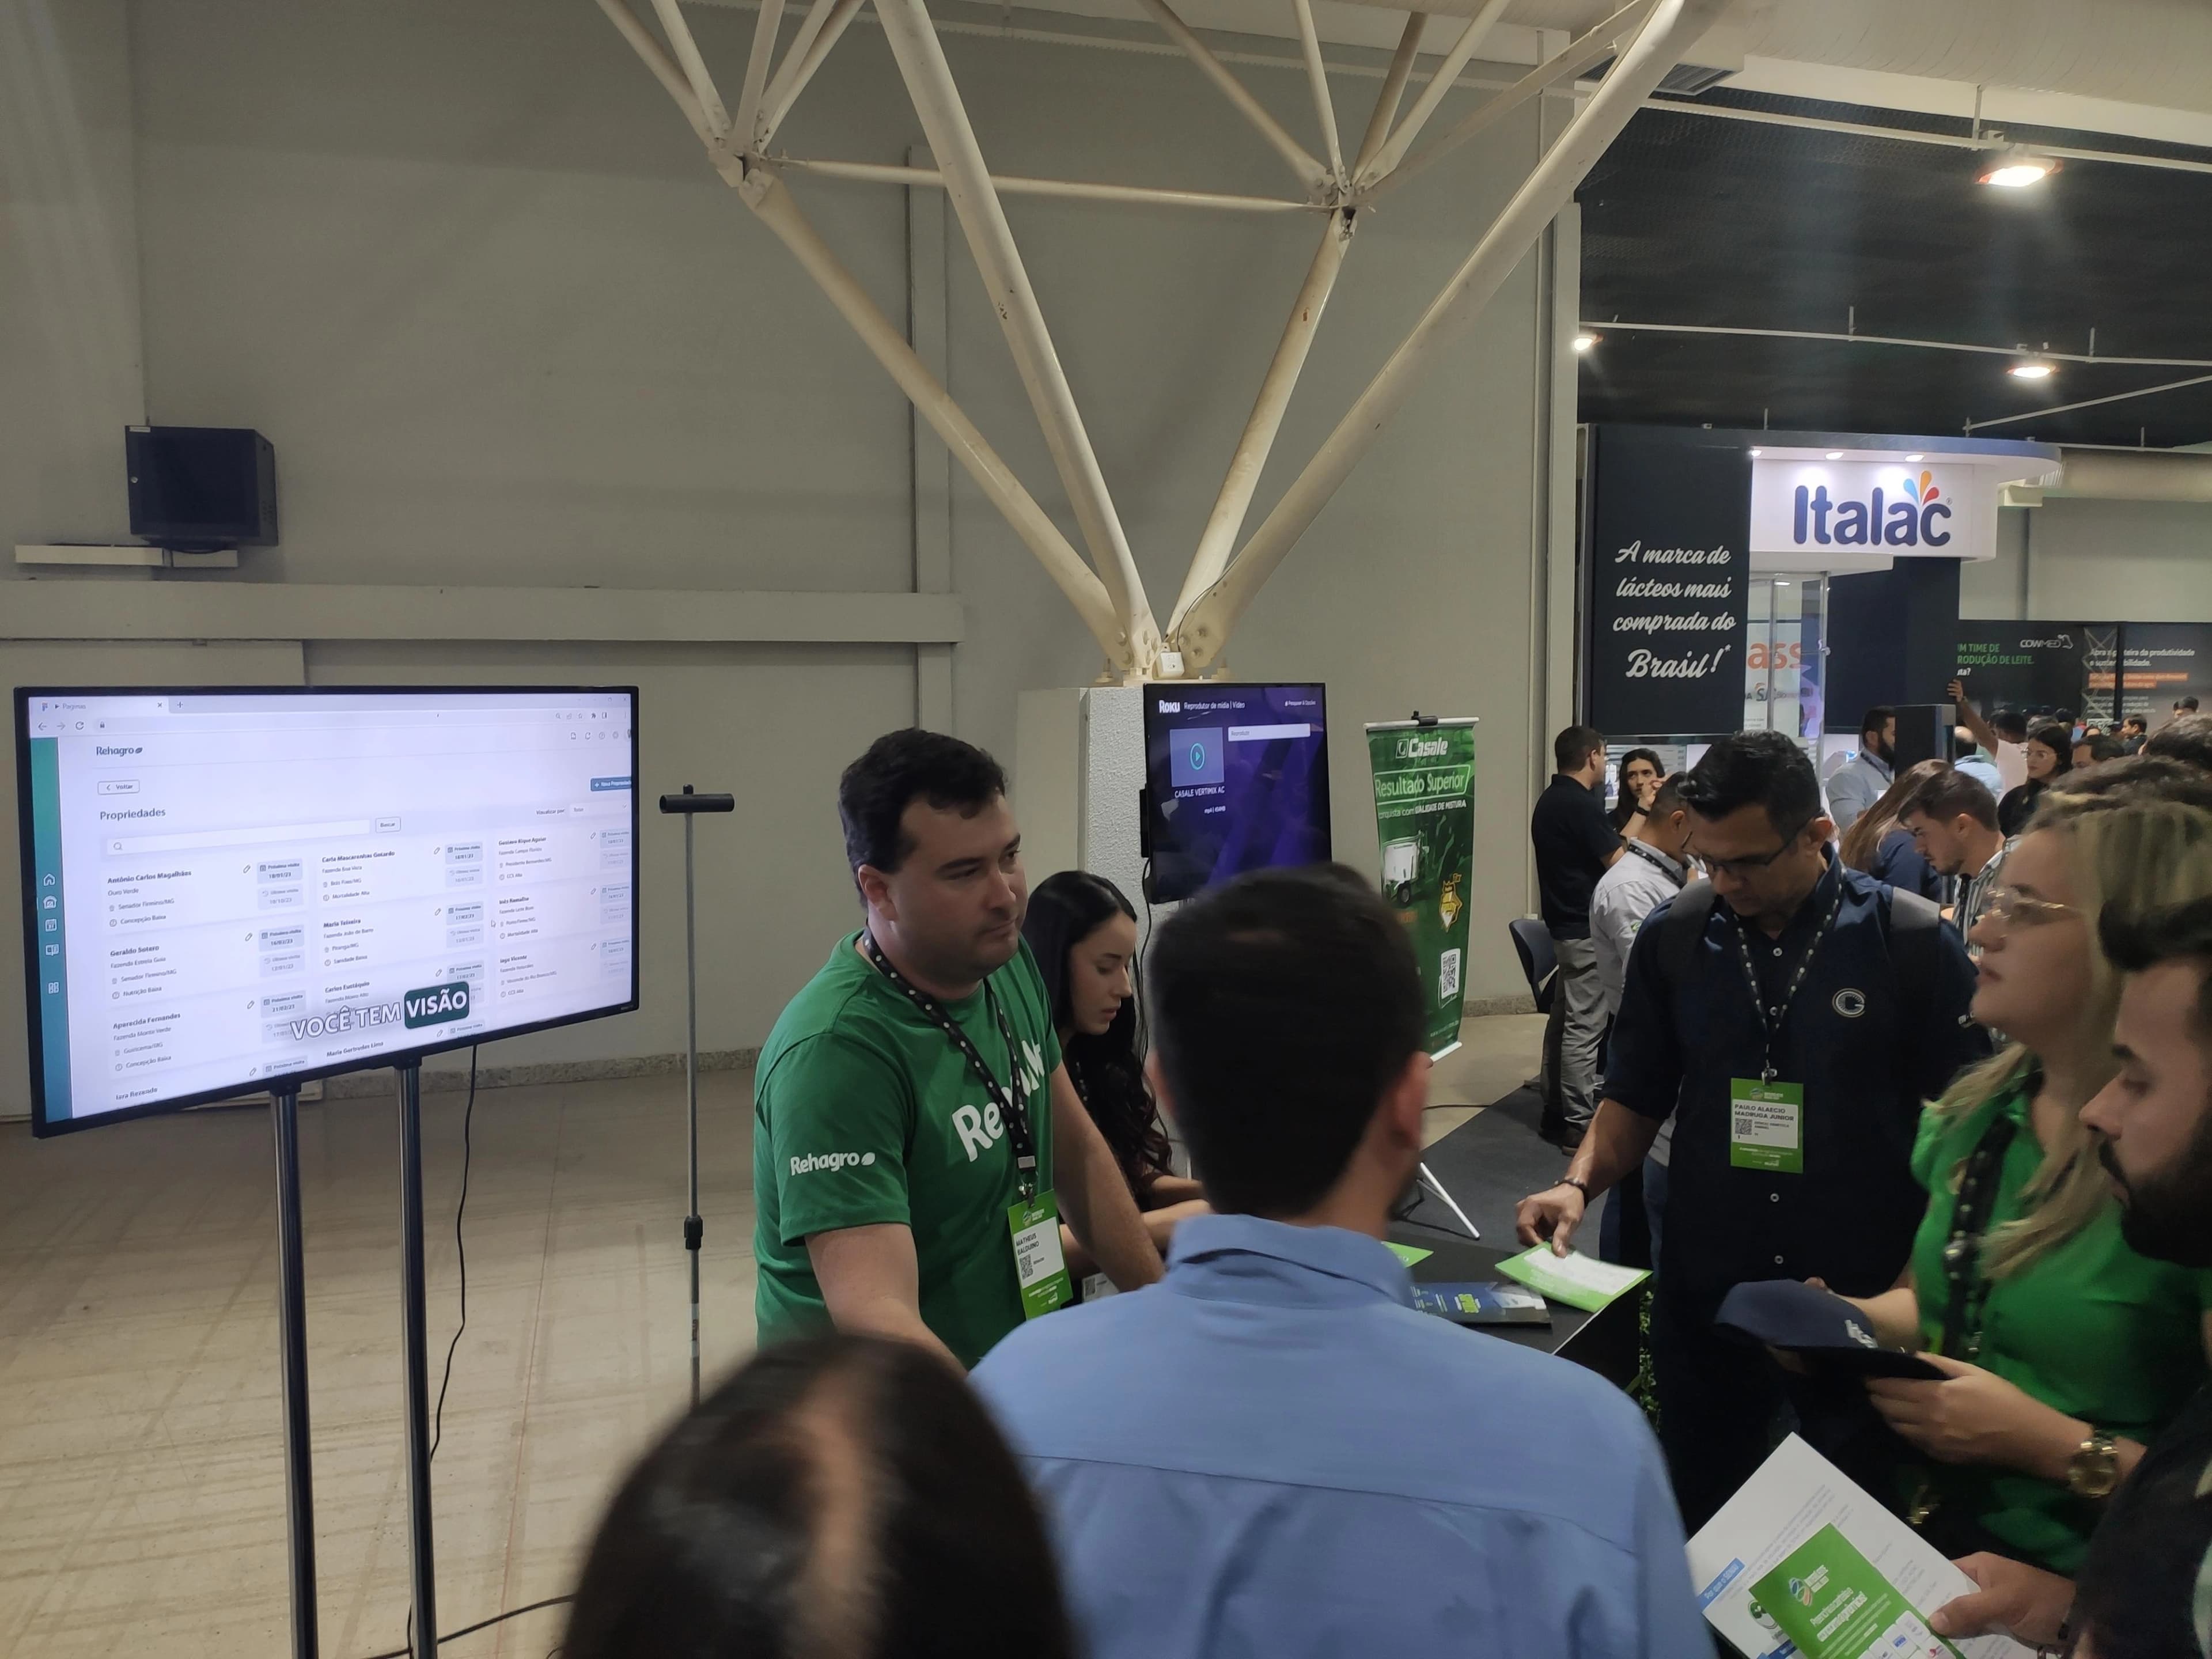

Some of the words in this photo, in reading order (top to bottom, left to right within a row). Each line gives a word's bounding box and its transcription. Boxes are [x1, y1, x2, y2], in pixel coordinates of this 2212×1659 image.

[1794, 485, 1951, 547] Italac
[1615, 540, 1641, 563] A
[1642, 548, 1706, 564] marca
[1706, 545, 1732, 565] de
[1616, 576, 1683, 597] lácteos
[1684, 576, 1732, 598] mais
[1612, 611, 1710, 635] comprada
[1710, 611, 1736, 631] do
[1968, 643, 1987, 652] TIME
[1989, 643, 2000, 652] DE
[2149, 649, 2195, 658] produtividade
[1999, 656, 2010, 664] DE
[1184, 702, 1210, 710] Reprodutor
[96, 746, 134, 757] Rehagro
[1408, 737, 1448, 757] Casale
[1374, 775, 1425, 797] Resultado
[1427, 772, 1464, 794] Superior
[100, 808, 166, 821] Propriedades
[108, 876, 134, 884] Antônio
[110, 948, 137, 957] Geraldo
[290, 1005, 351, 1040] VOCÊ
[355, 1002, 402, 1028] TEM
[406, 988, 467, 1018] VISÃO
[113, 1019, 146, 1030] Aparecida
[147, 1013, 180, 1024] Fernandes
[1735, 1111, 1768, 1119] MADRUGA
[790, 1152, 859, 1176] Rehagro
[1016, 1233, 1037, 1247] MATHEUS
